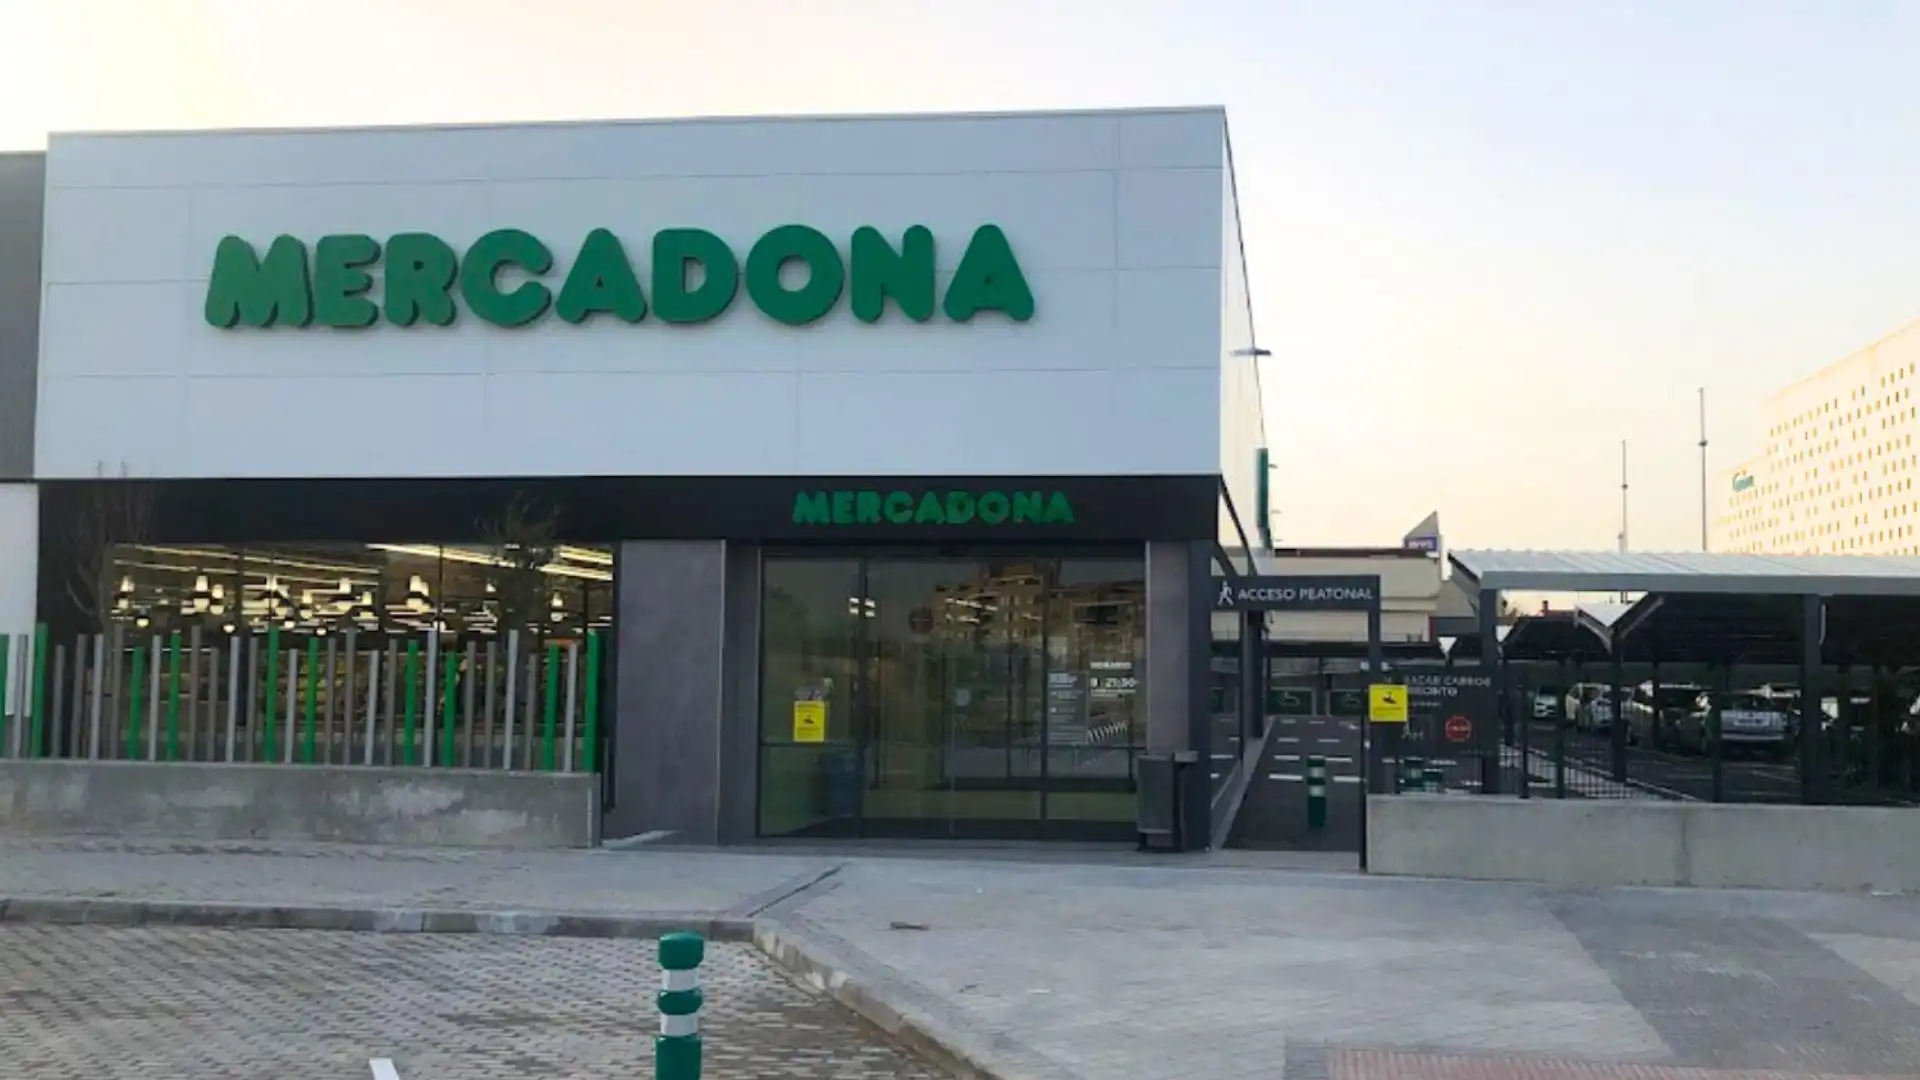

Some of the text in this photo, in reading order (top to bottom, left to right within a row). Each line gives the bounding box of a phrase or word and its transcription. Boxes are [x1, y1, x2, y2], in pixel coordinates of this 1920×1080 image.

[205, 224, 1036, 327] MERCADONA
[792, 489, 1075, 525] MERCADONA
[1238, 588, 1374, 601] ACCESO PEATONAL
